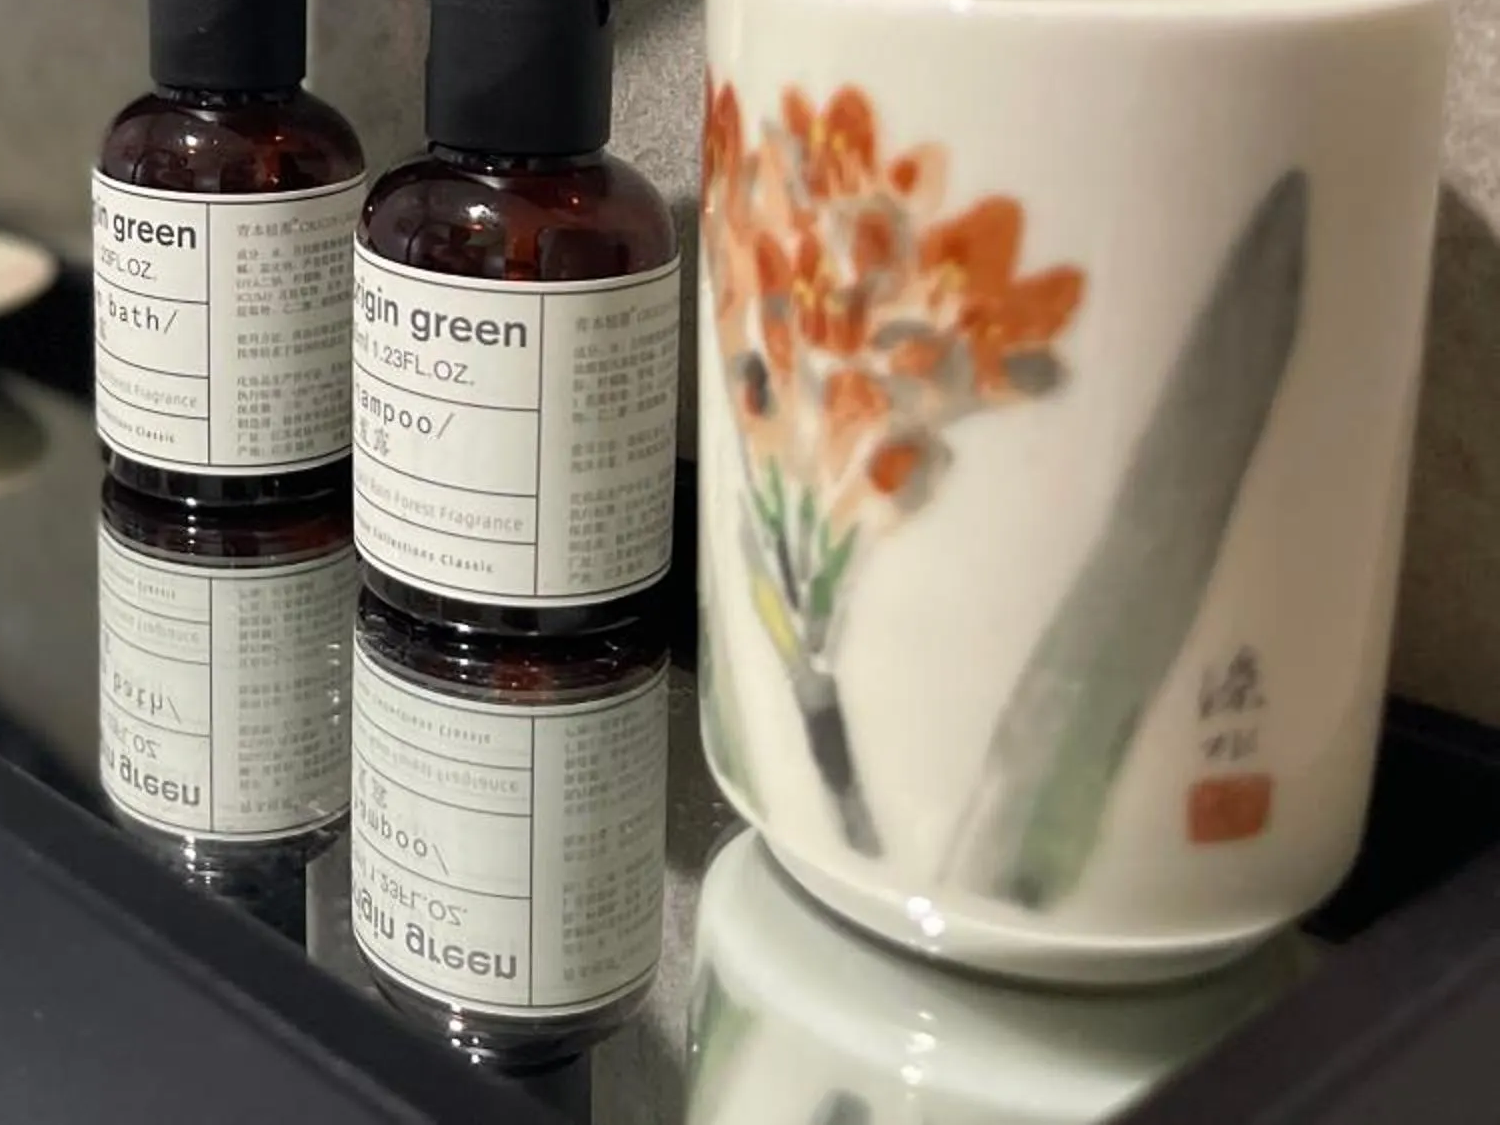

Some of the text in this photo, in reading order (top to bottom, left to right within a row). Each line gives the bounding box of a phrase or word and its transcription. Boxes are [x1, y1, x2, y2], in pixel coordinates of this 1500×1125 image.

[113, 213, 197, 249] green
[108, 291, 179, 334] bath/
[410, 308, 527, 349] green
[440, 505, 526, 534] Fragrance
